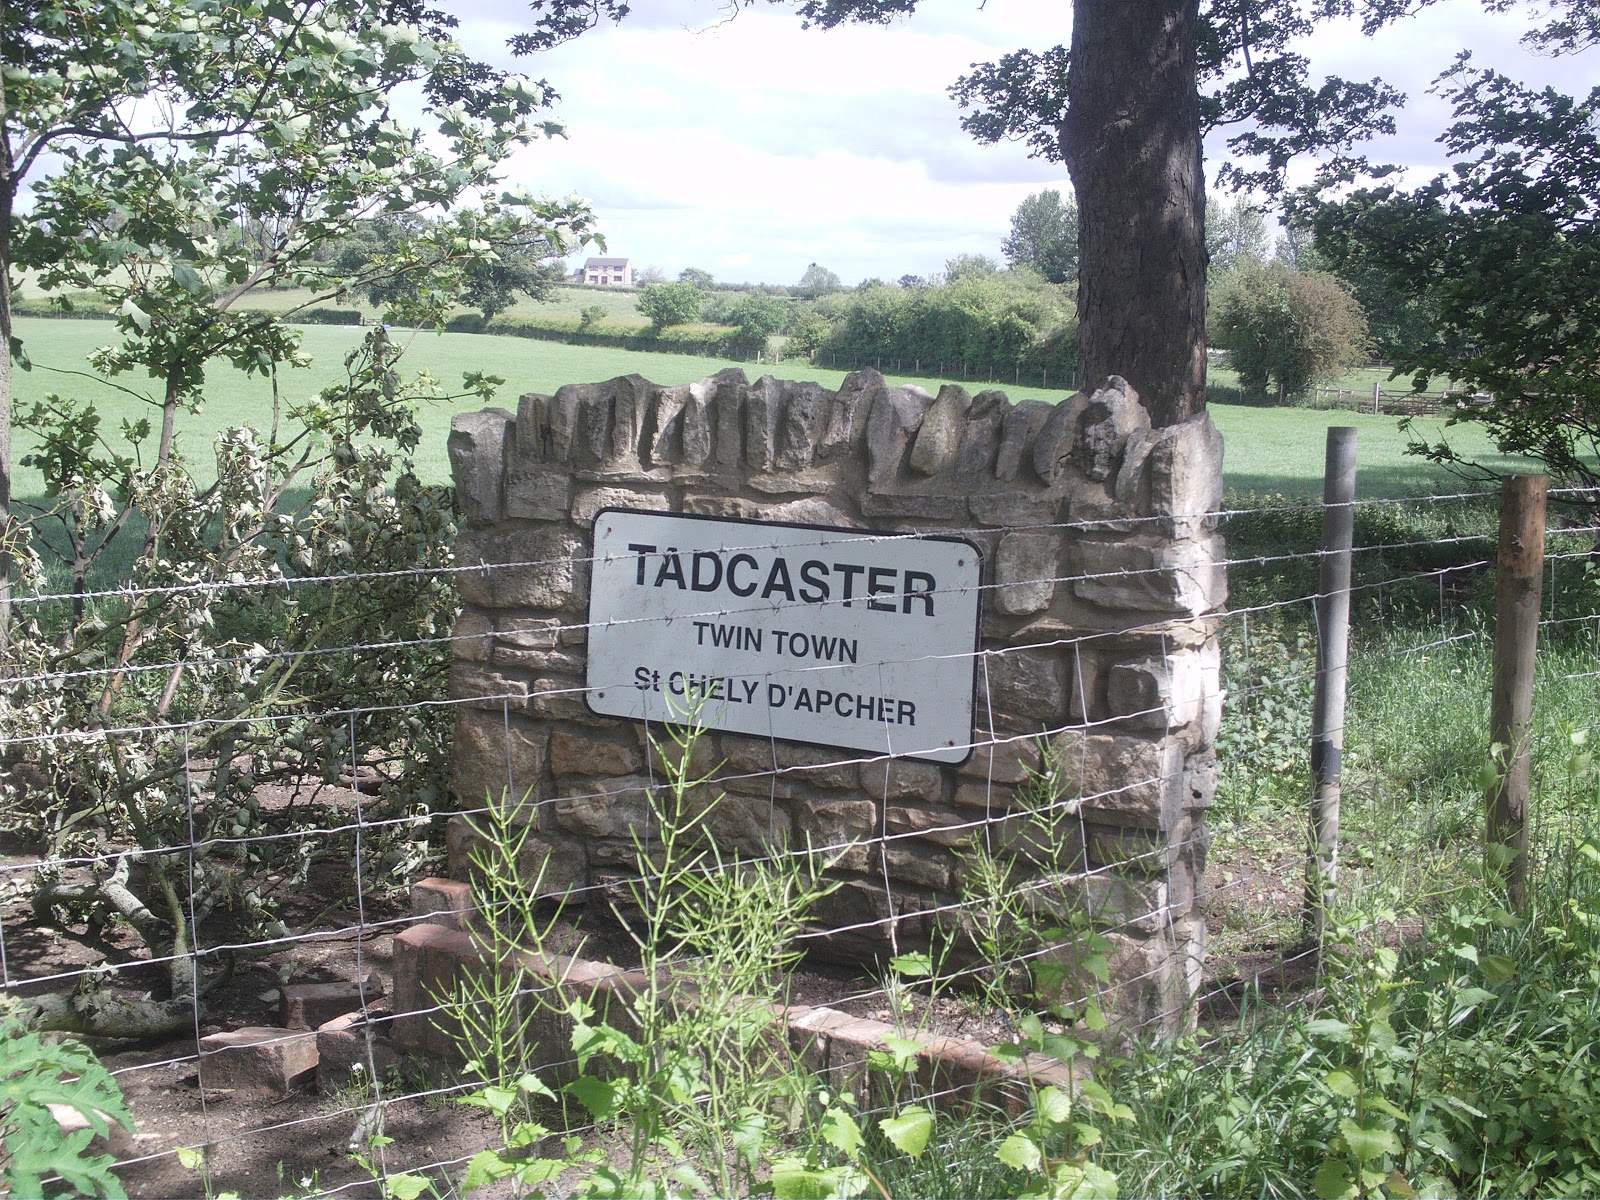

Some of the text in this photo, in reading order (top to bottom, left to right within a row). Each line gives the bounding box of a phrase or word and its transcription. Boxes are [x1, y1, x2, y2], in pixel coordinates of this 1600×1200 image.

[628, 543, 936, 617] TADCASTER
[693, 621, 858, 664] TWIN TOWN
[634, 666, 916, 726] St CHELY D'APCHER
